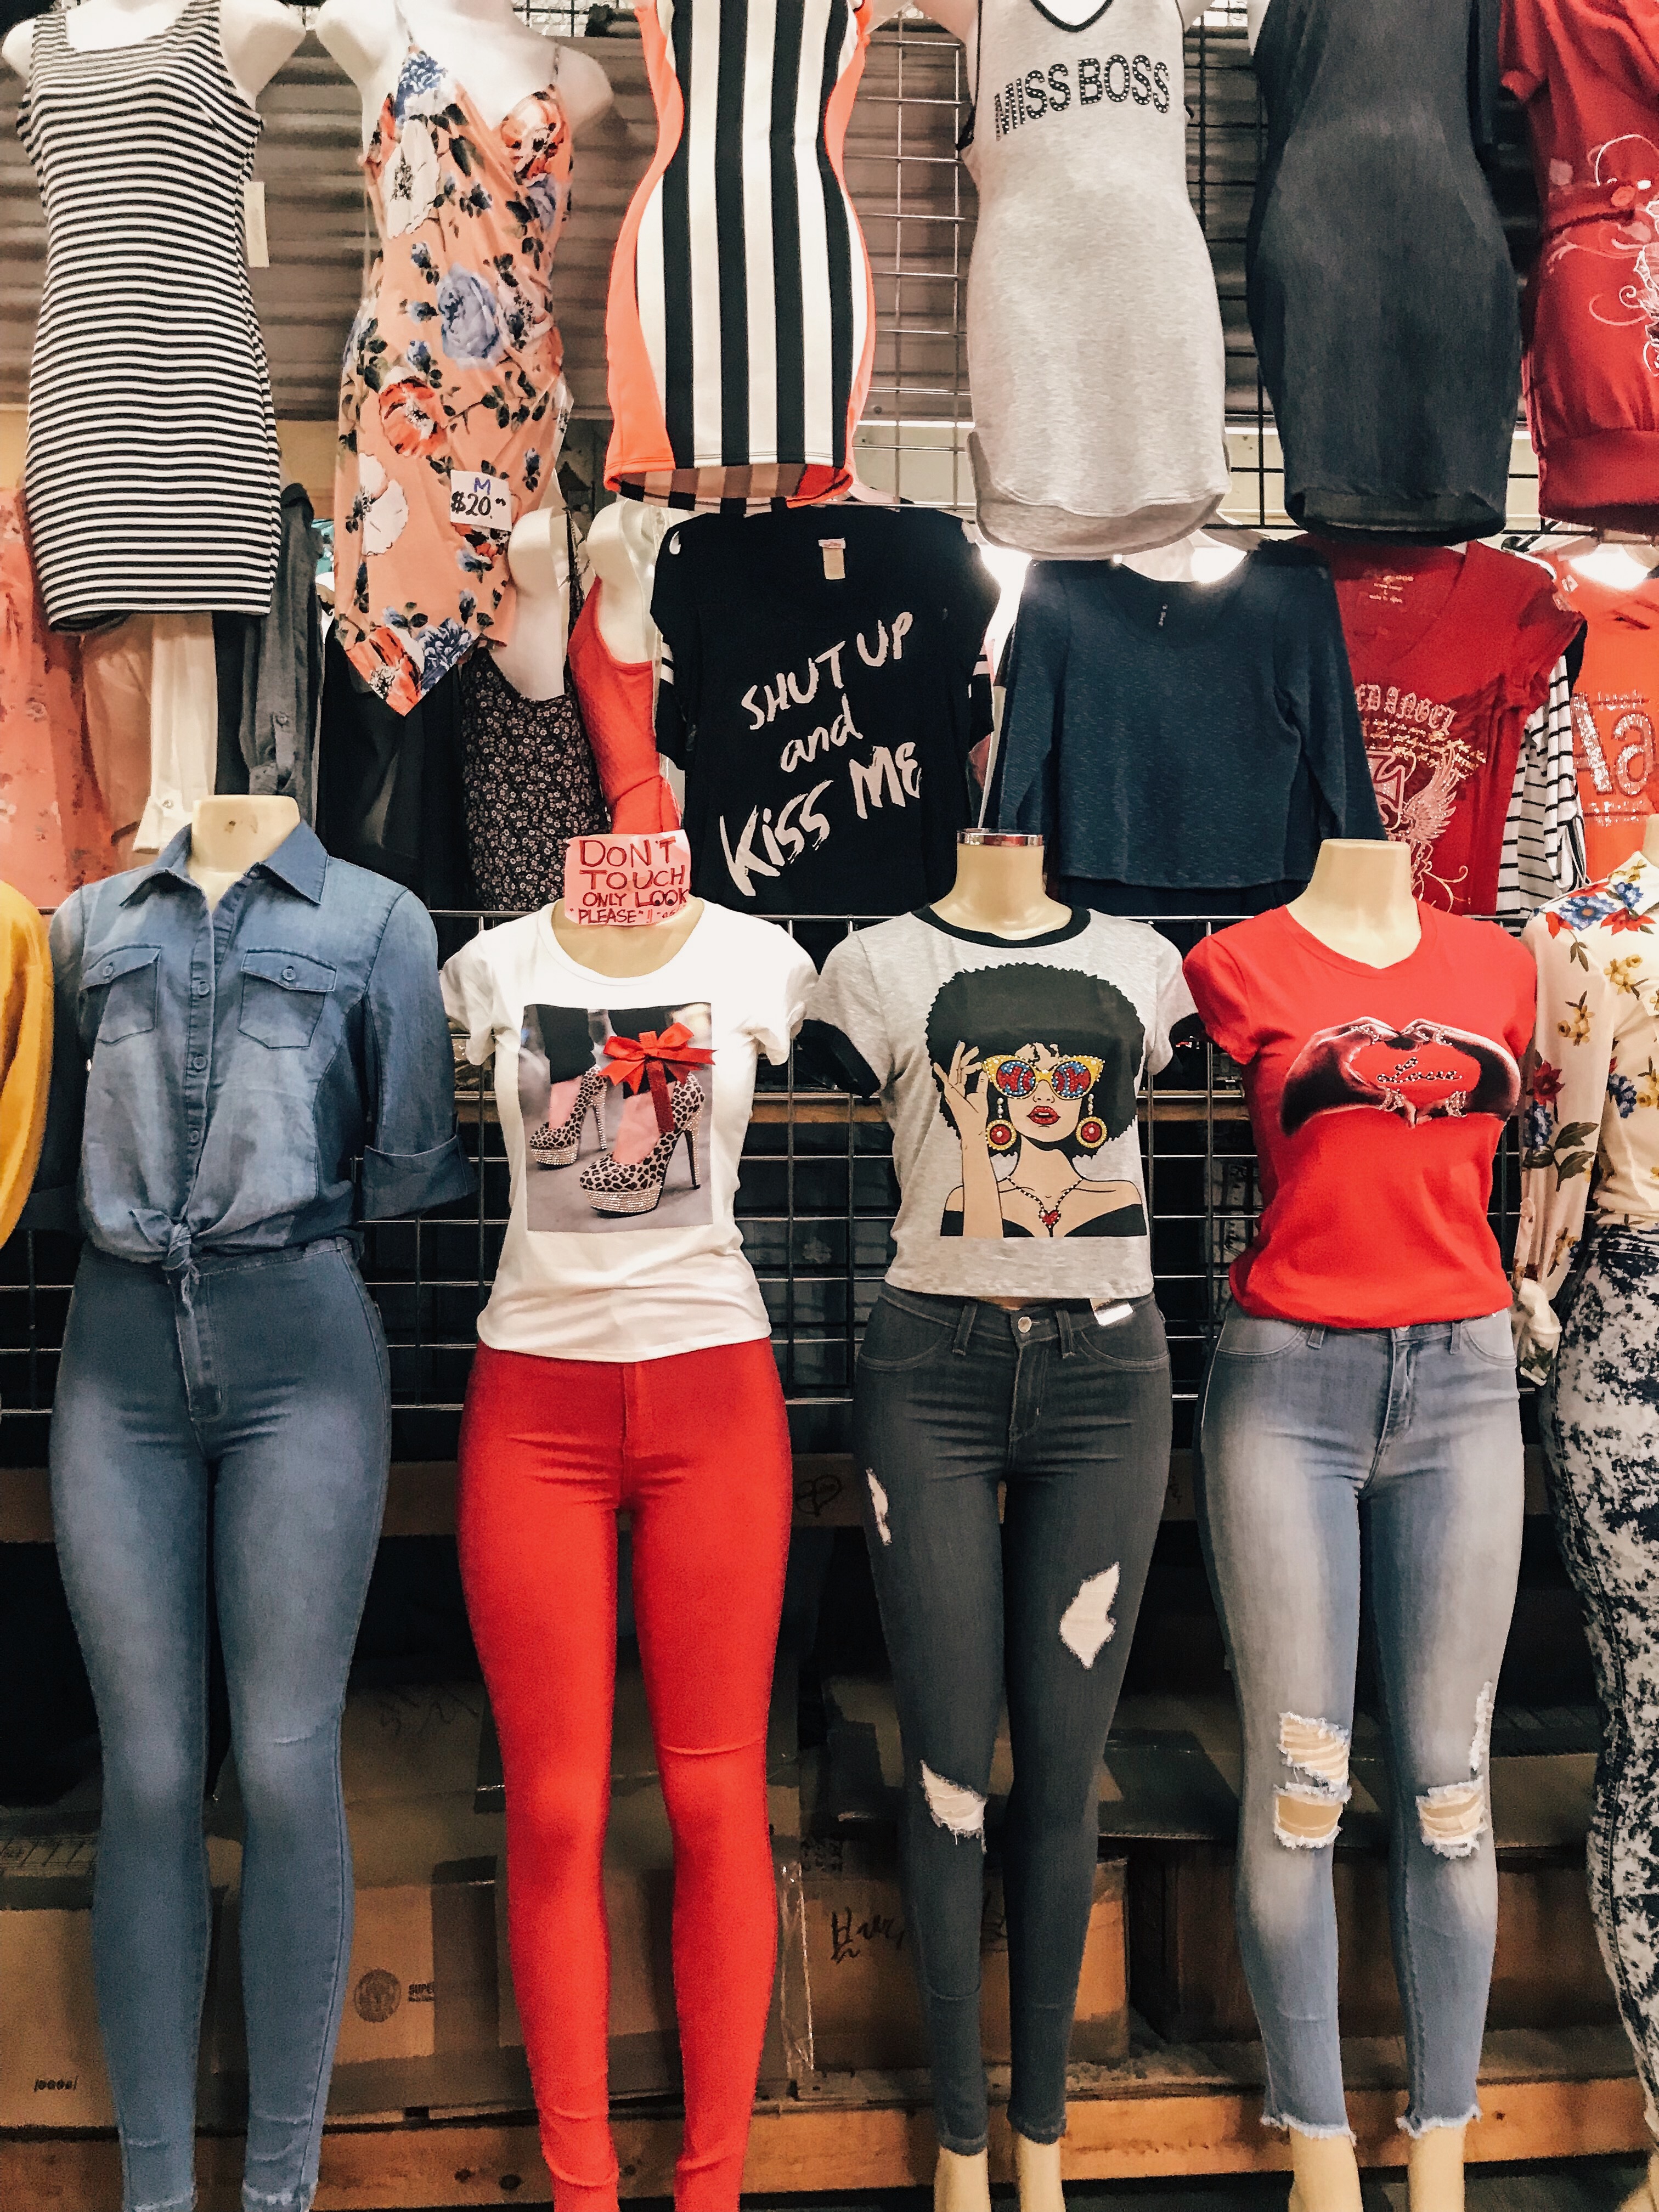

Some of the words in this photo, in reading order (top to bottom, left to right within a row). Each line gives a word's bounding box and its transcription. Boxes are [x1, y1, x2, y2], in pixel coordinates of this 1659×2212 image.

[994, 63, 1071, 142] MISS
[1077, 53, 1170, 114] BOSS
[473, 477, 491, 495] M
[741, 640, 845, 731] SHUT
[856, 611, 914, 668] UP
[779, 693, 864, 773] and
[849, 742, 922, 820] ME
[579, 836, 676, 868] DON'T
[579, 865, 686, 890] TOUCH
[583, 891, 627, 907] ONLY
[635, 888, 690, 908] LOOK
[1376, 1055, 1463, 1084] Love
